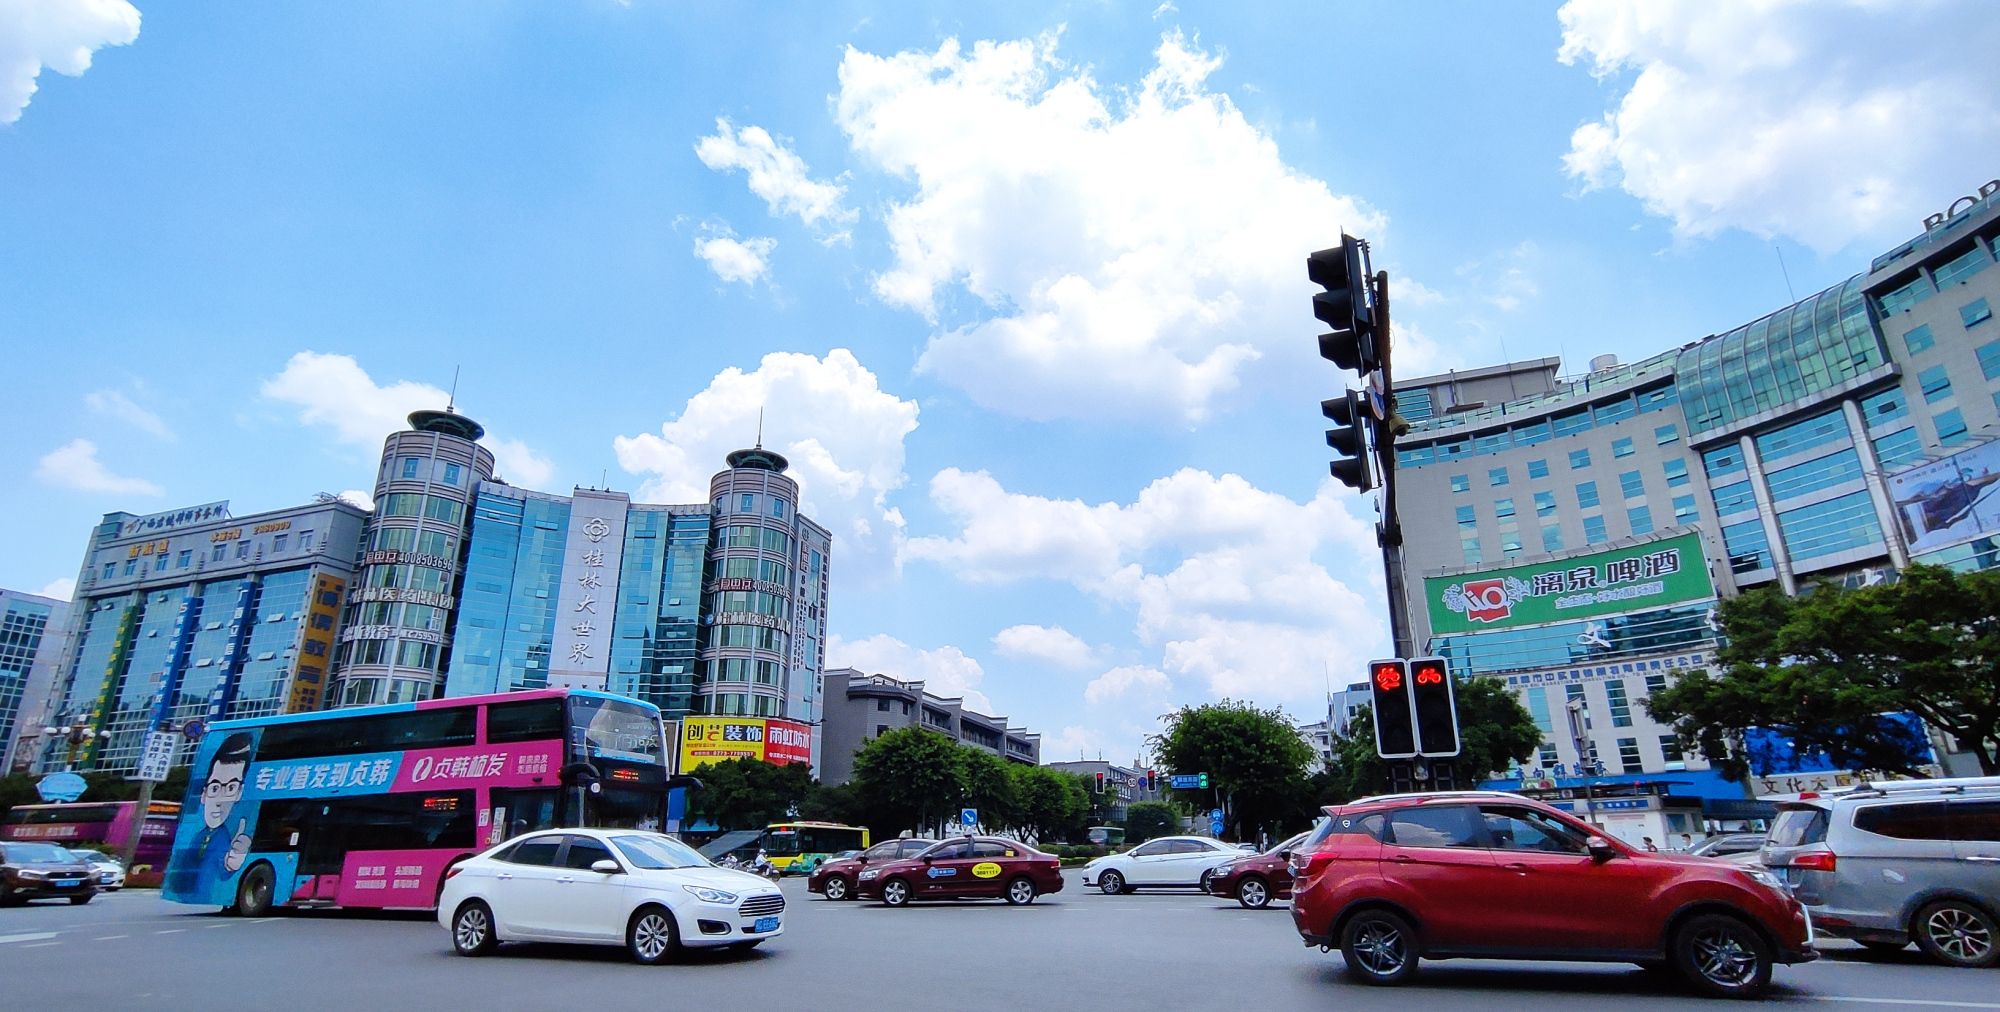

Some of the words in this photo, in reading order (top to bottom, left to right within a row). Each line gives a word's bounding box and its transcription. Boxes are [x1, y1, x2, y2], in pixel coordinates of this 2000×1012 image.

[399, 551, 453, 571] 4008503696
[1532, 548, 1680, 597] 漓泉啤酒
[352, 587, 454, 610] 桂林医药集团
[568, 549, 604, 665] 桂林大世界
[687, 724, 763, 742] 创艺装饰
[769, 726, 810, 749] 雨虹防水
[255, 758, 393, 791] 专业植发到贞韩
[432, 752, 508, 780] 贞韩植发
